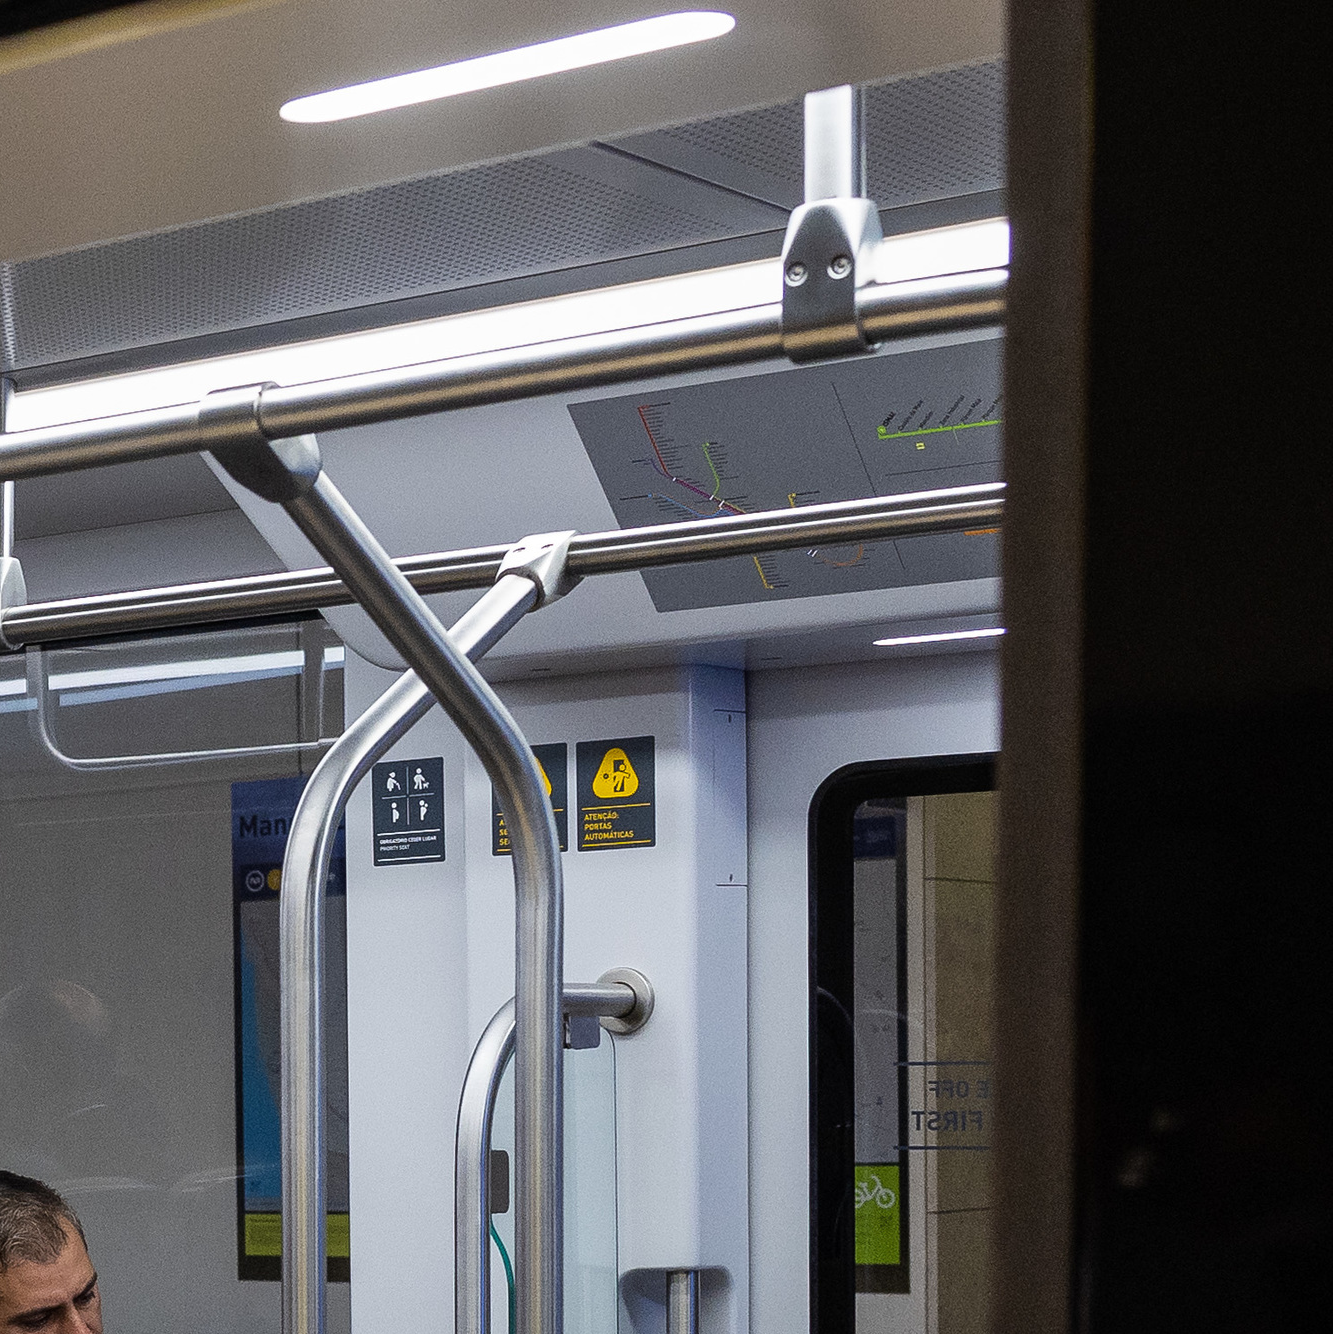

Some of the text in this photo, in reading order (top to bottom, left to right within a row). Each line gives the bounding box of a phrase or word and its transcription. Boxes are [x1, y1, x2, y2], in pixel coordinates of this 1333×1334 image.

[239, 815, 292, 838] Man
[584, 822, 612, 830] PORTAS
[584, 830, 634, 841] AUTOMÁTICAS
